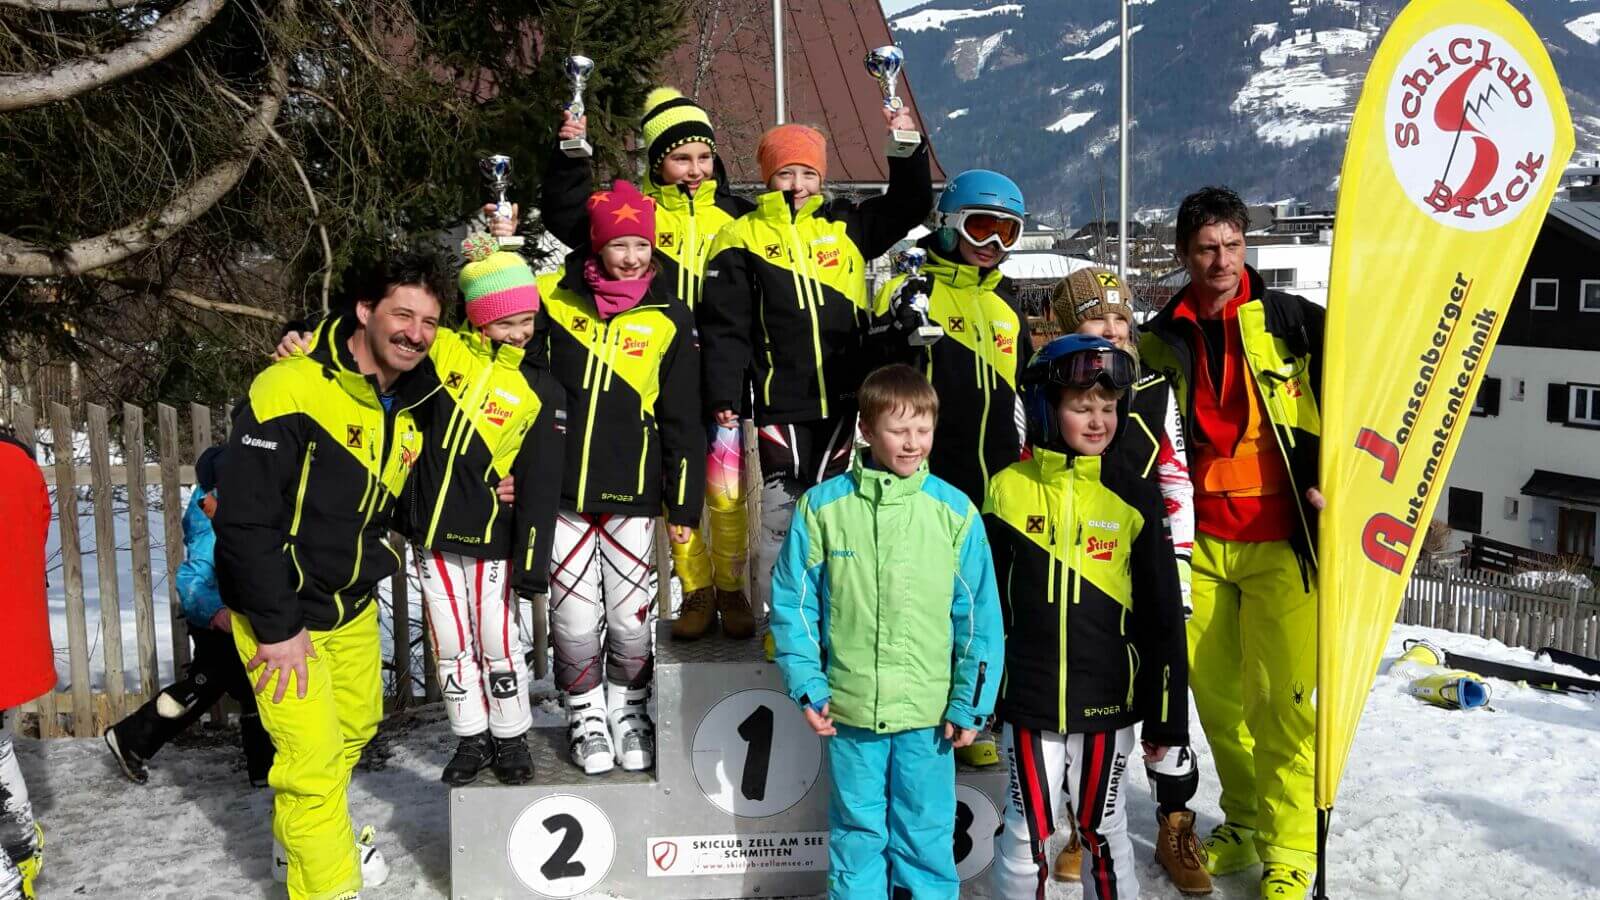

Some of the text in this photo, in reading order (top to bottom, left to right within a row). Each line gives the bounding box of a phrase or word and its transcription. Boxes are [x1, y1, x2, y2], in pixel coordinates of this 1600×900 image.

[1394, 37, 1533, 149] SchiClub
[1423, 152, 1544, 218] Bruck
[1354, 272, 1471, 484] Jansenberger
[1361, 307, 1497, 576] Automatentechnik
[601, 492, 634, 502] SPYDER
[446, 533, 481, 544] SPYDER
[1087, 536, 1118, 553] Stiegl
[1084, 705, 1121, 717] SPYDER
[737, 704, 774, 801] 1
[1103, 751, 1127, 818] VUARNET
[540, 813, 586, 880] 2
[693, 837, 825, 850] SKICLUB ZELL AM SEE
[724, 848, 792, 858] SCHMITTEN
[702, 860, 814, 869] www.skiclub-zellamsee.at
